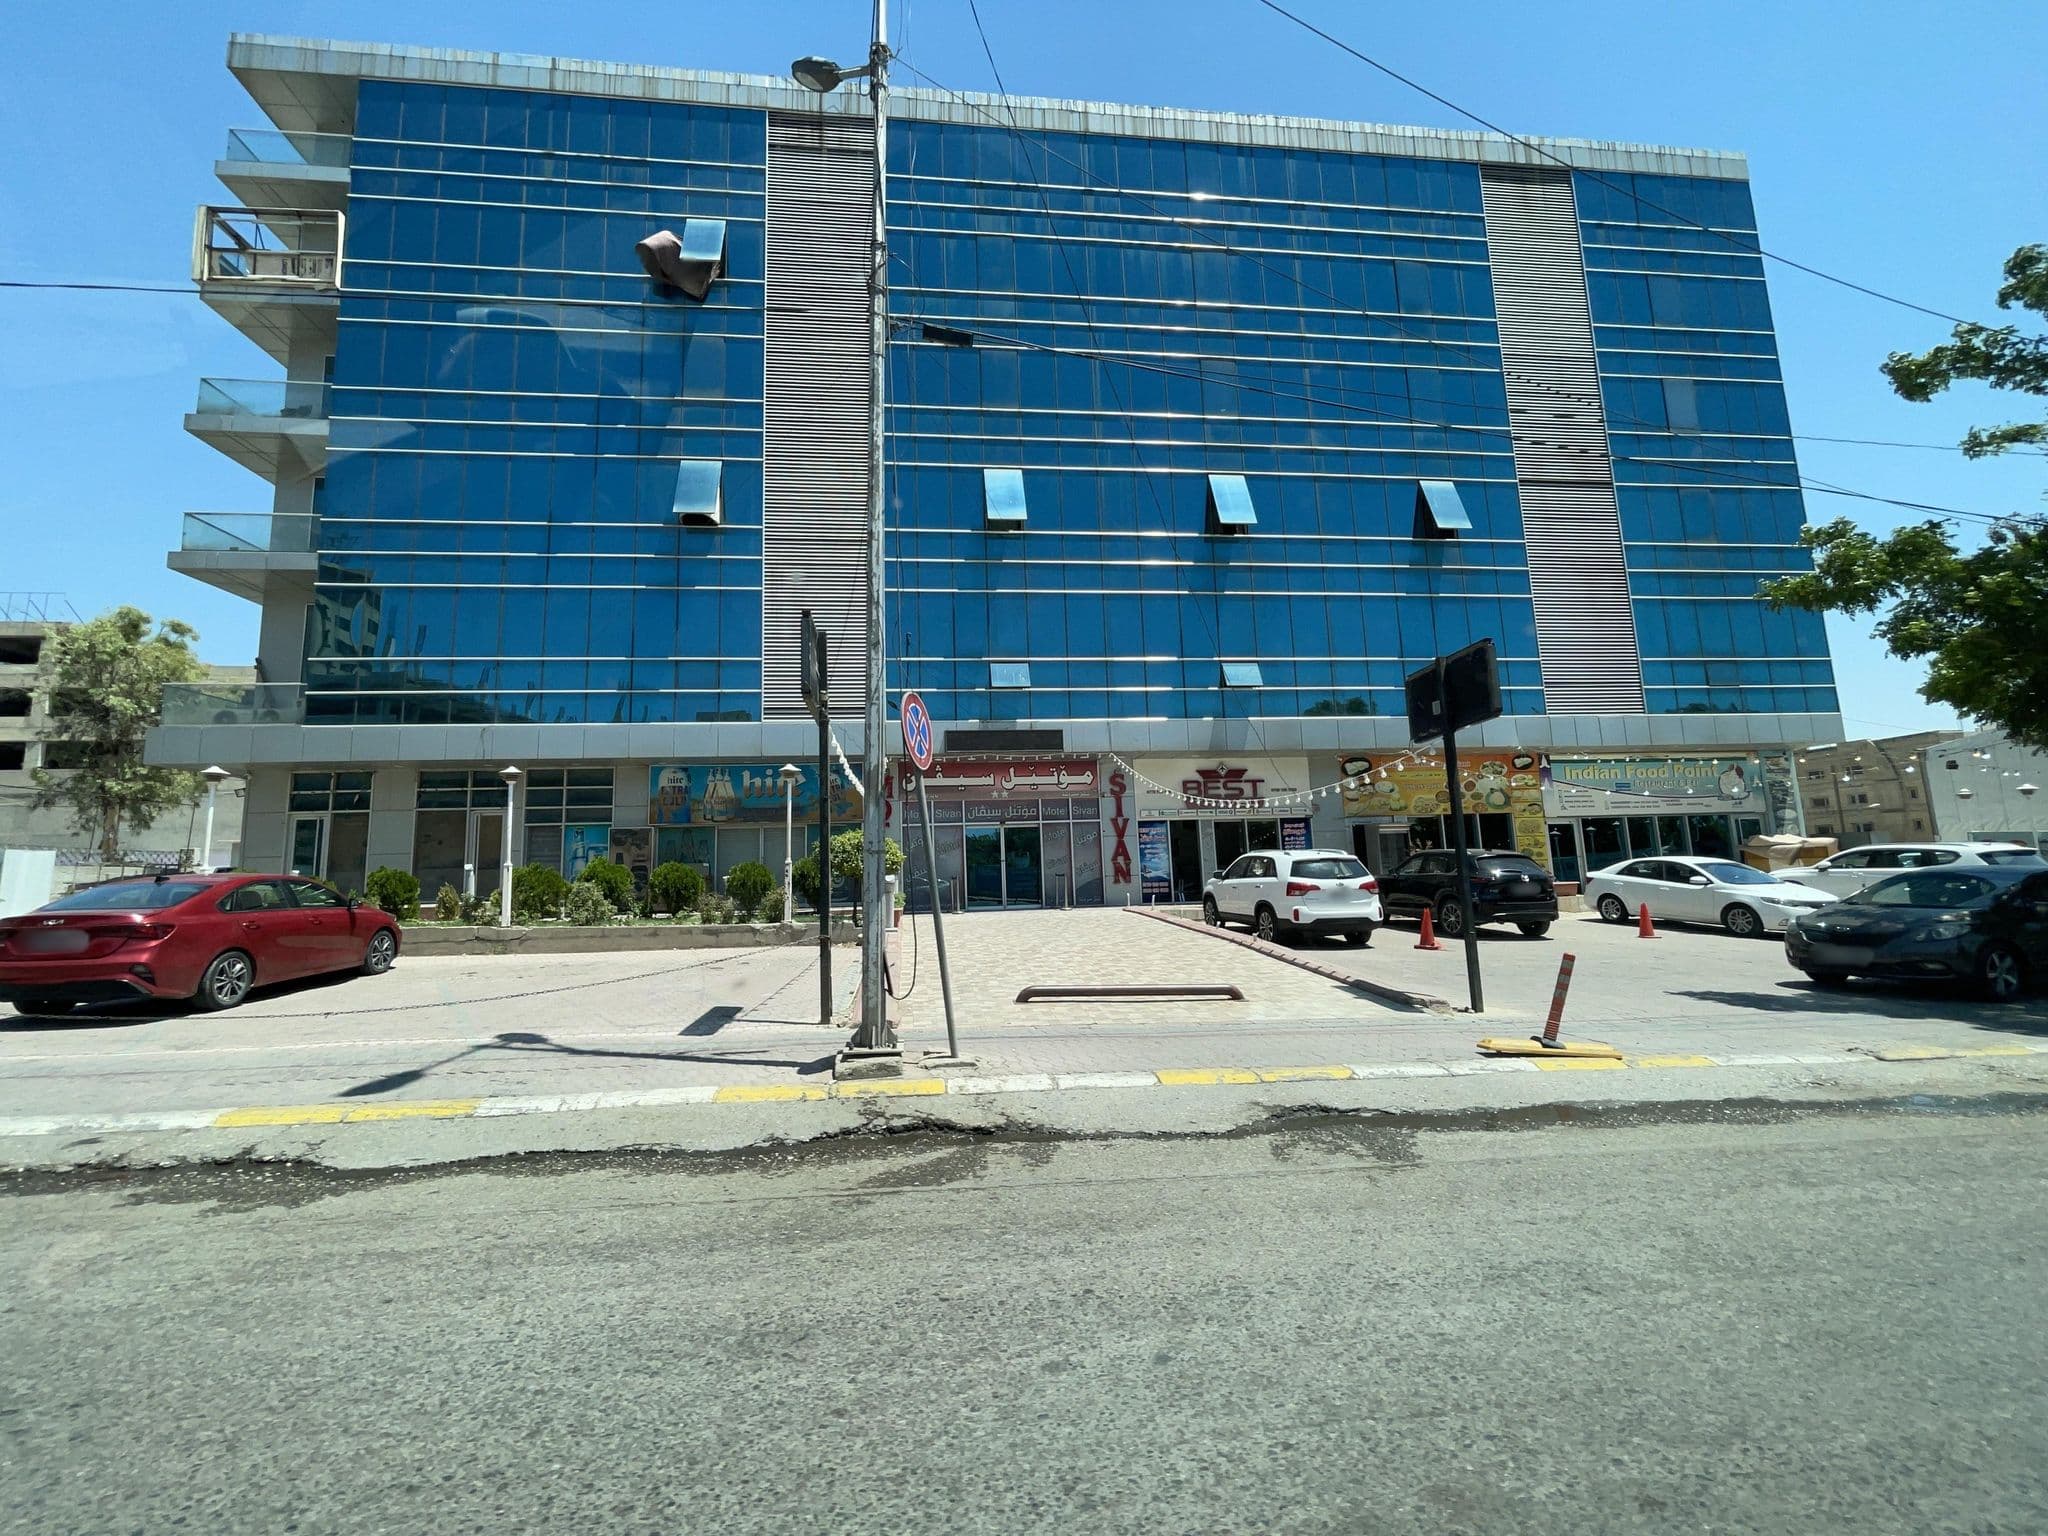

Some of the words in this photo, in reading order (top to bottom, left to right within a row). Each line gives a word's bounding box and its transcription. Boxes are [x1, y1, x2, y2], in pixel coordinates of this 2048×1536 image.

[903, 764, 995, 791] سیڤن
[1564, 764, 1620, 780] Indian
[1625, 764, 1667, 779] Food
[1672, 763, 1718, 778] Point
[1182, 779, 1265, 799] BEST
[935, 808, 961, 818] Sivan
[1072, 806, 1098, 815] Sivan
[1110, 770, 1132, 884] SIVAN
